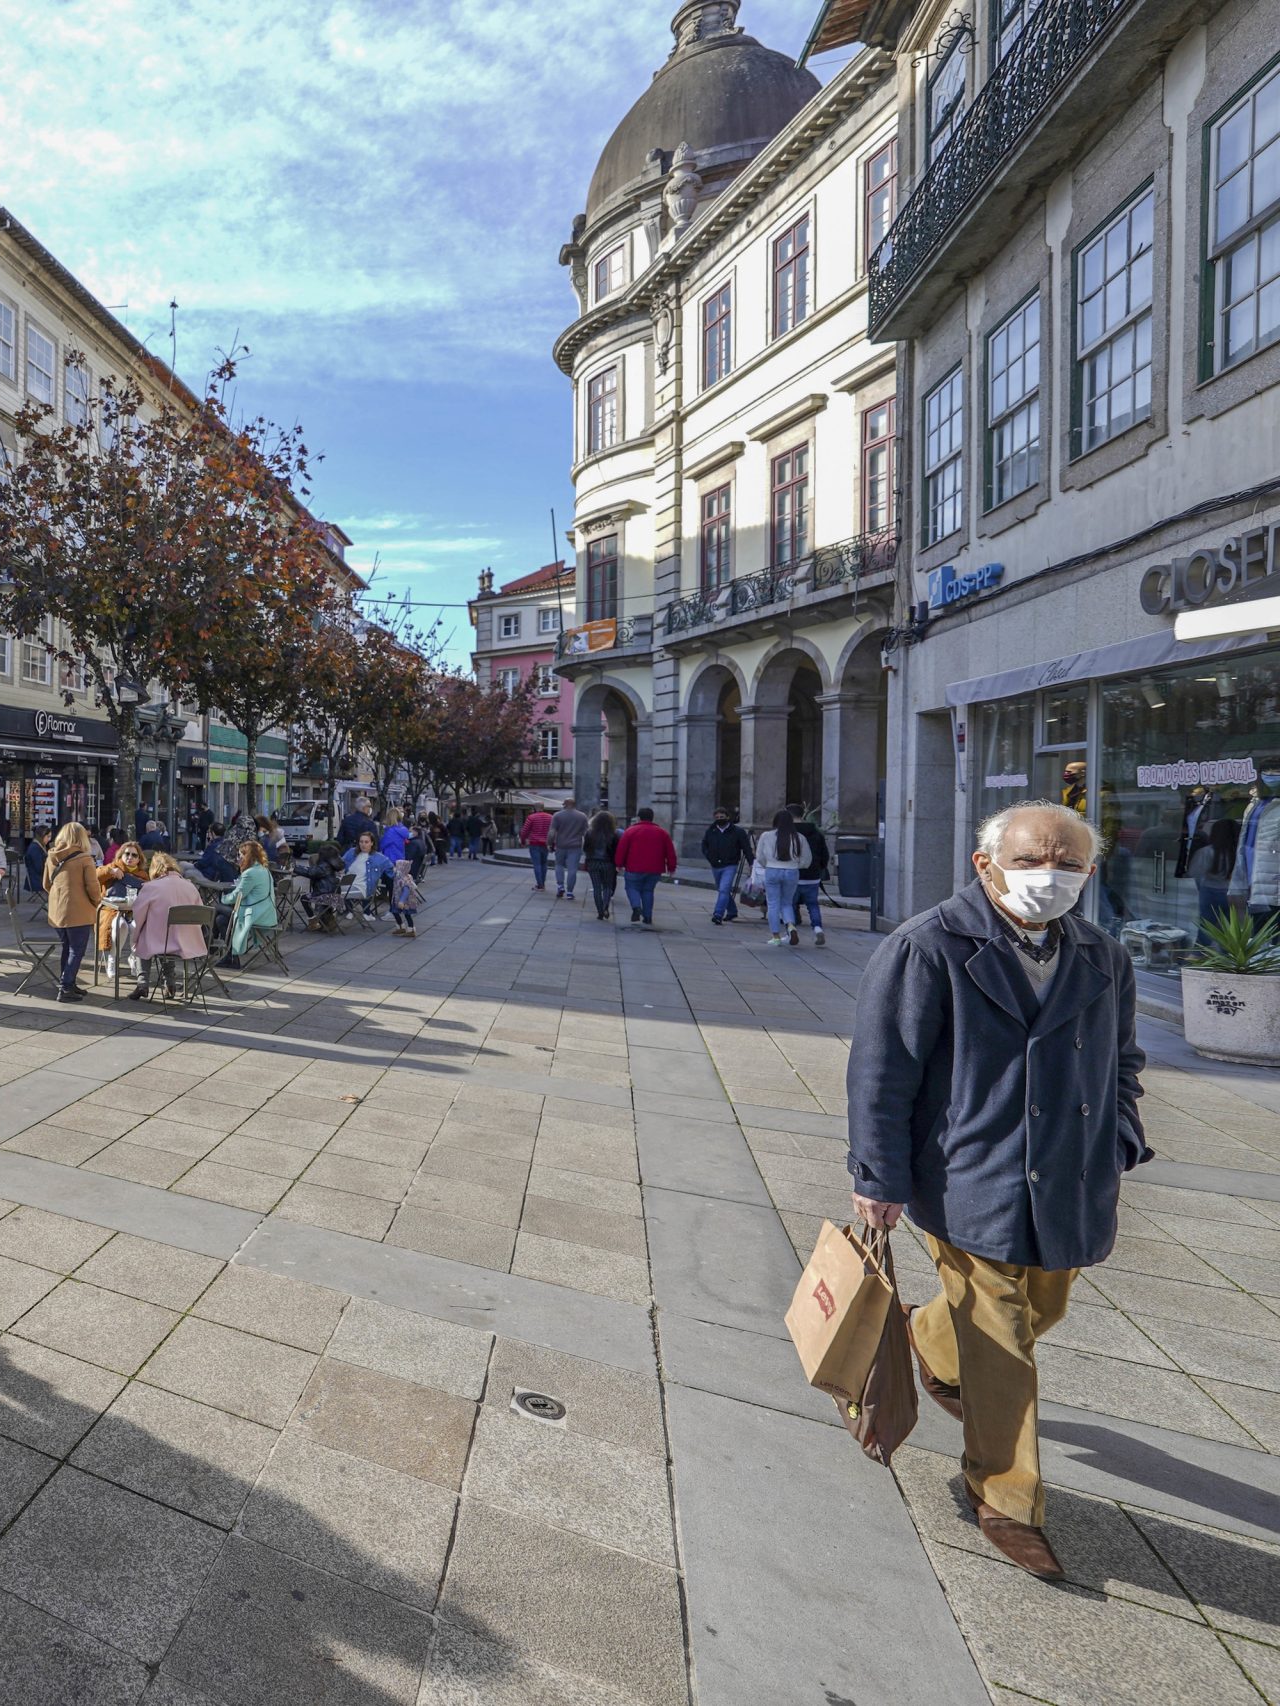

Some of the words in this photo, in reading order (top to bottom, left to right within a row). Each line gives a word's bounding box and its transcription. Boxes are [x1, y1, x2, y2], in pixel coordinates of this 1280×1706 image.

[1137, 760, 1200, 789] PROMOÇÕES
[1201, 761, 1218, 785] DE
[1218, 758, 1257, 784] NATAL
